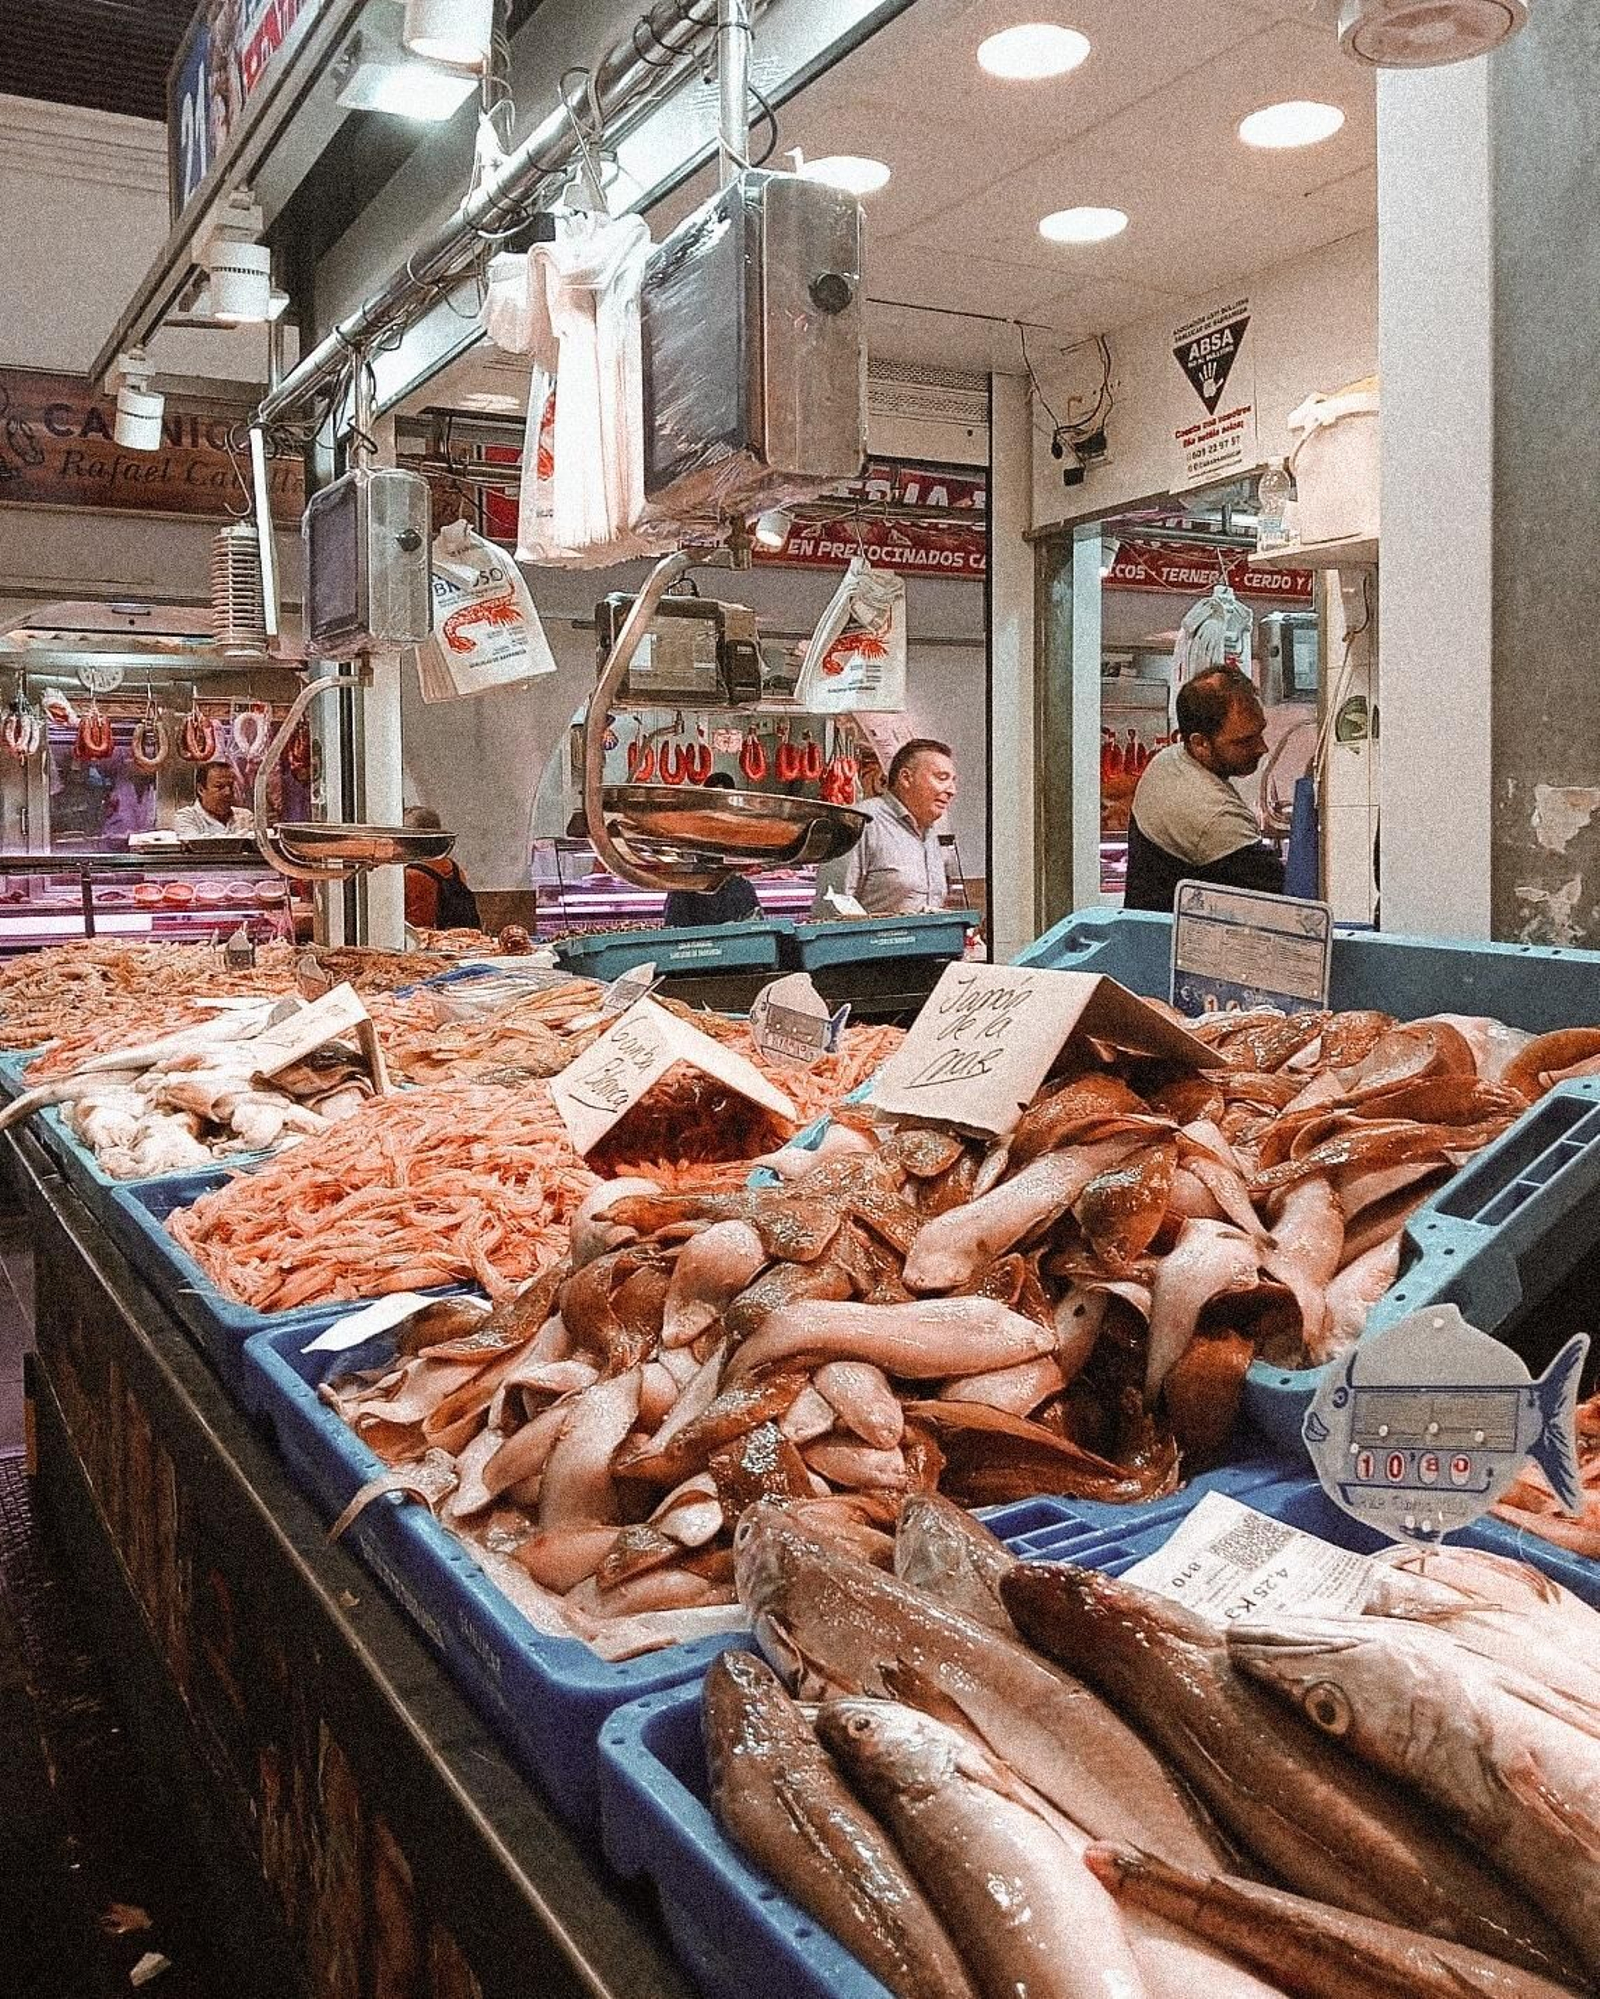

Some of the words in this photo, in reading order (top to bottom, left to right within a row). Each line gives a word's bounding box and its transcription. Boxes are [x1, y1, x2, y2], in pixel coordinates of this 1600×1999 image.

[1188, 329, 1233, 360] ABSA
[60, 450, 170, 487] Rafael
[788, 539, 814, 557] EN
[1243, 573, 1292, 590] CERDO
[1296, 576, 1306, 591] Y
[1171, 1560, 1202, 1589] 810
[1252, 1566, 1290, 1600] 4,25
